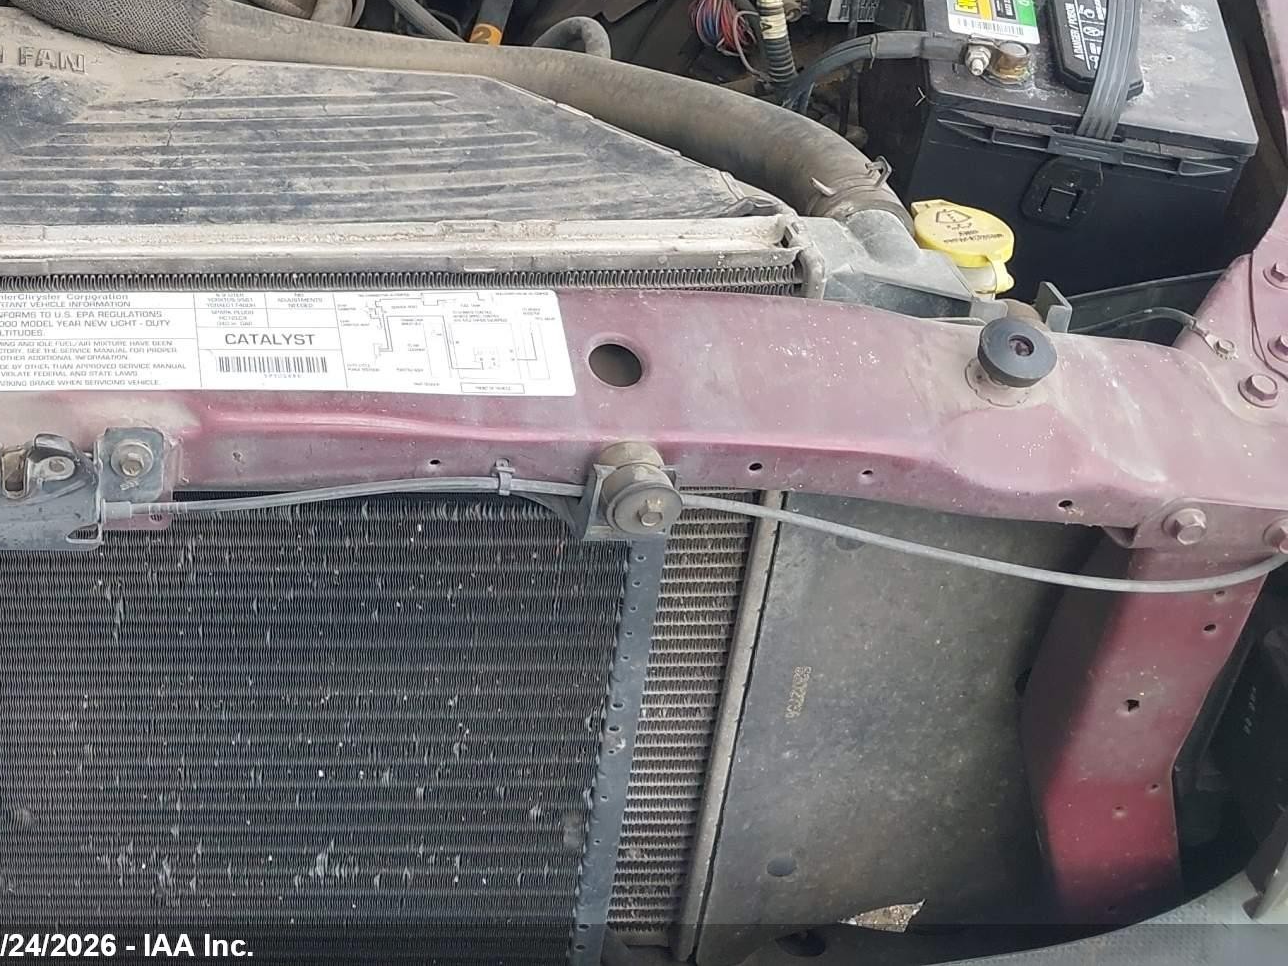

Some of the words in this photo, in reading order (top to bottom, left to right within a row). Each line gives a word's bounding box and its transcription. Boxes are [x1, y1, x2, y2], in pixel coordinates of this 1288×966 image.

[18, 46, 86, 74] FAN
[66, 293, 129, 301] Corporation
[97, 310, 162, 318] REGULATIONS
[20, 320, 54, 328] MODEL
[110, 319, 137, 327] LIGHT
[145, 319, 171, 327] DUTY
[224, 333, 316, 346] CATALYST
